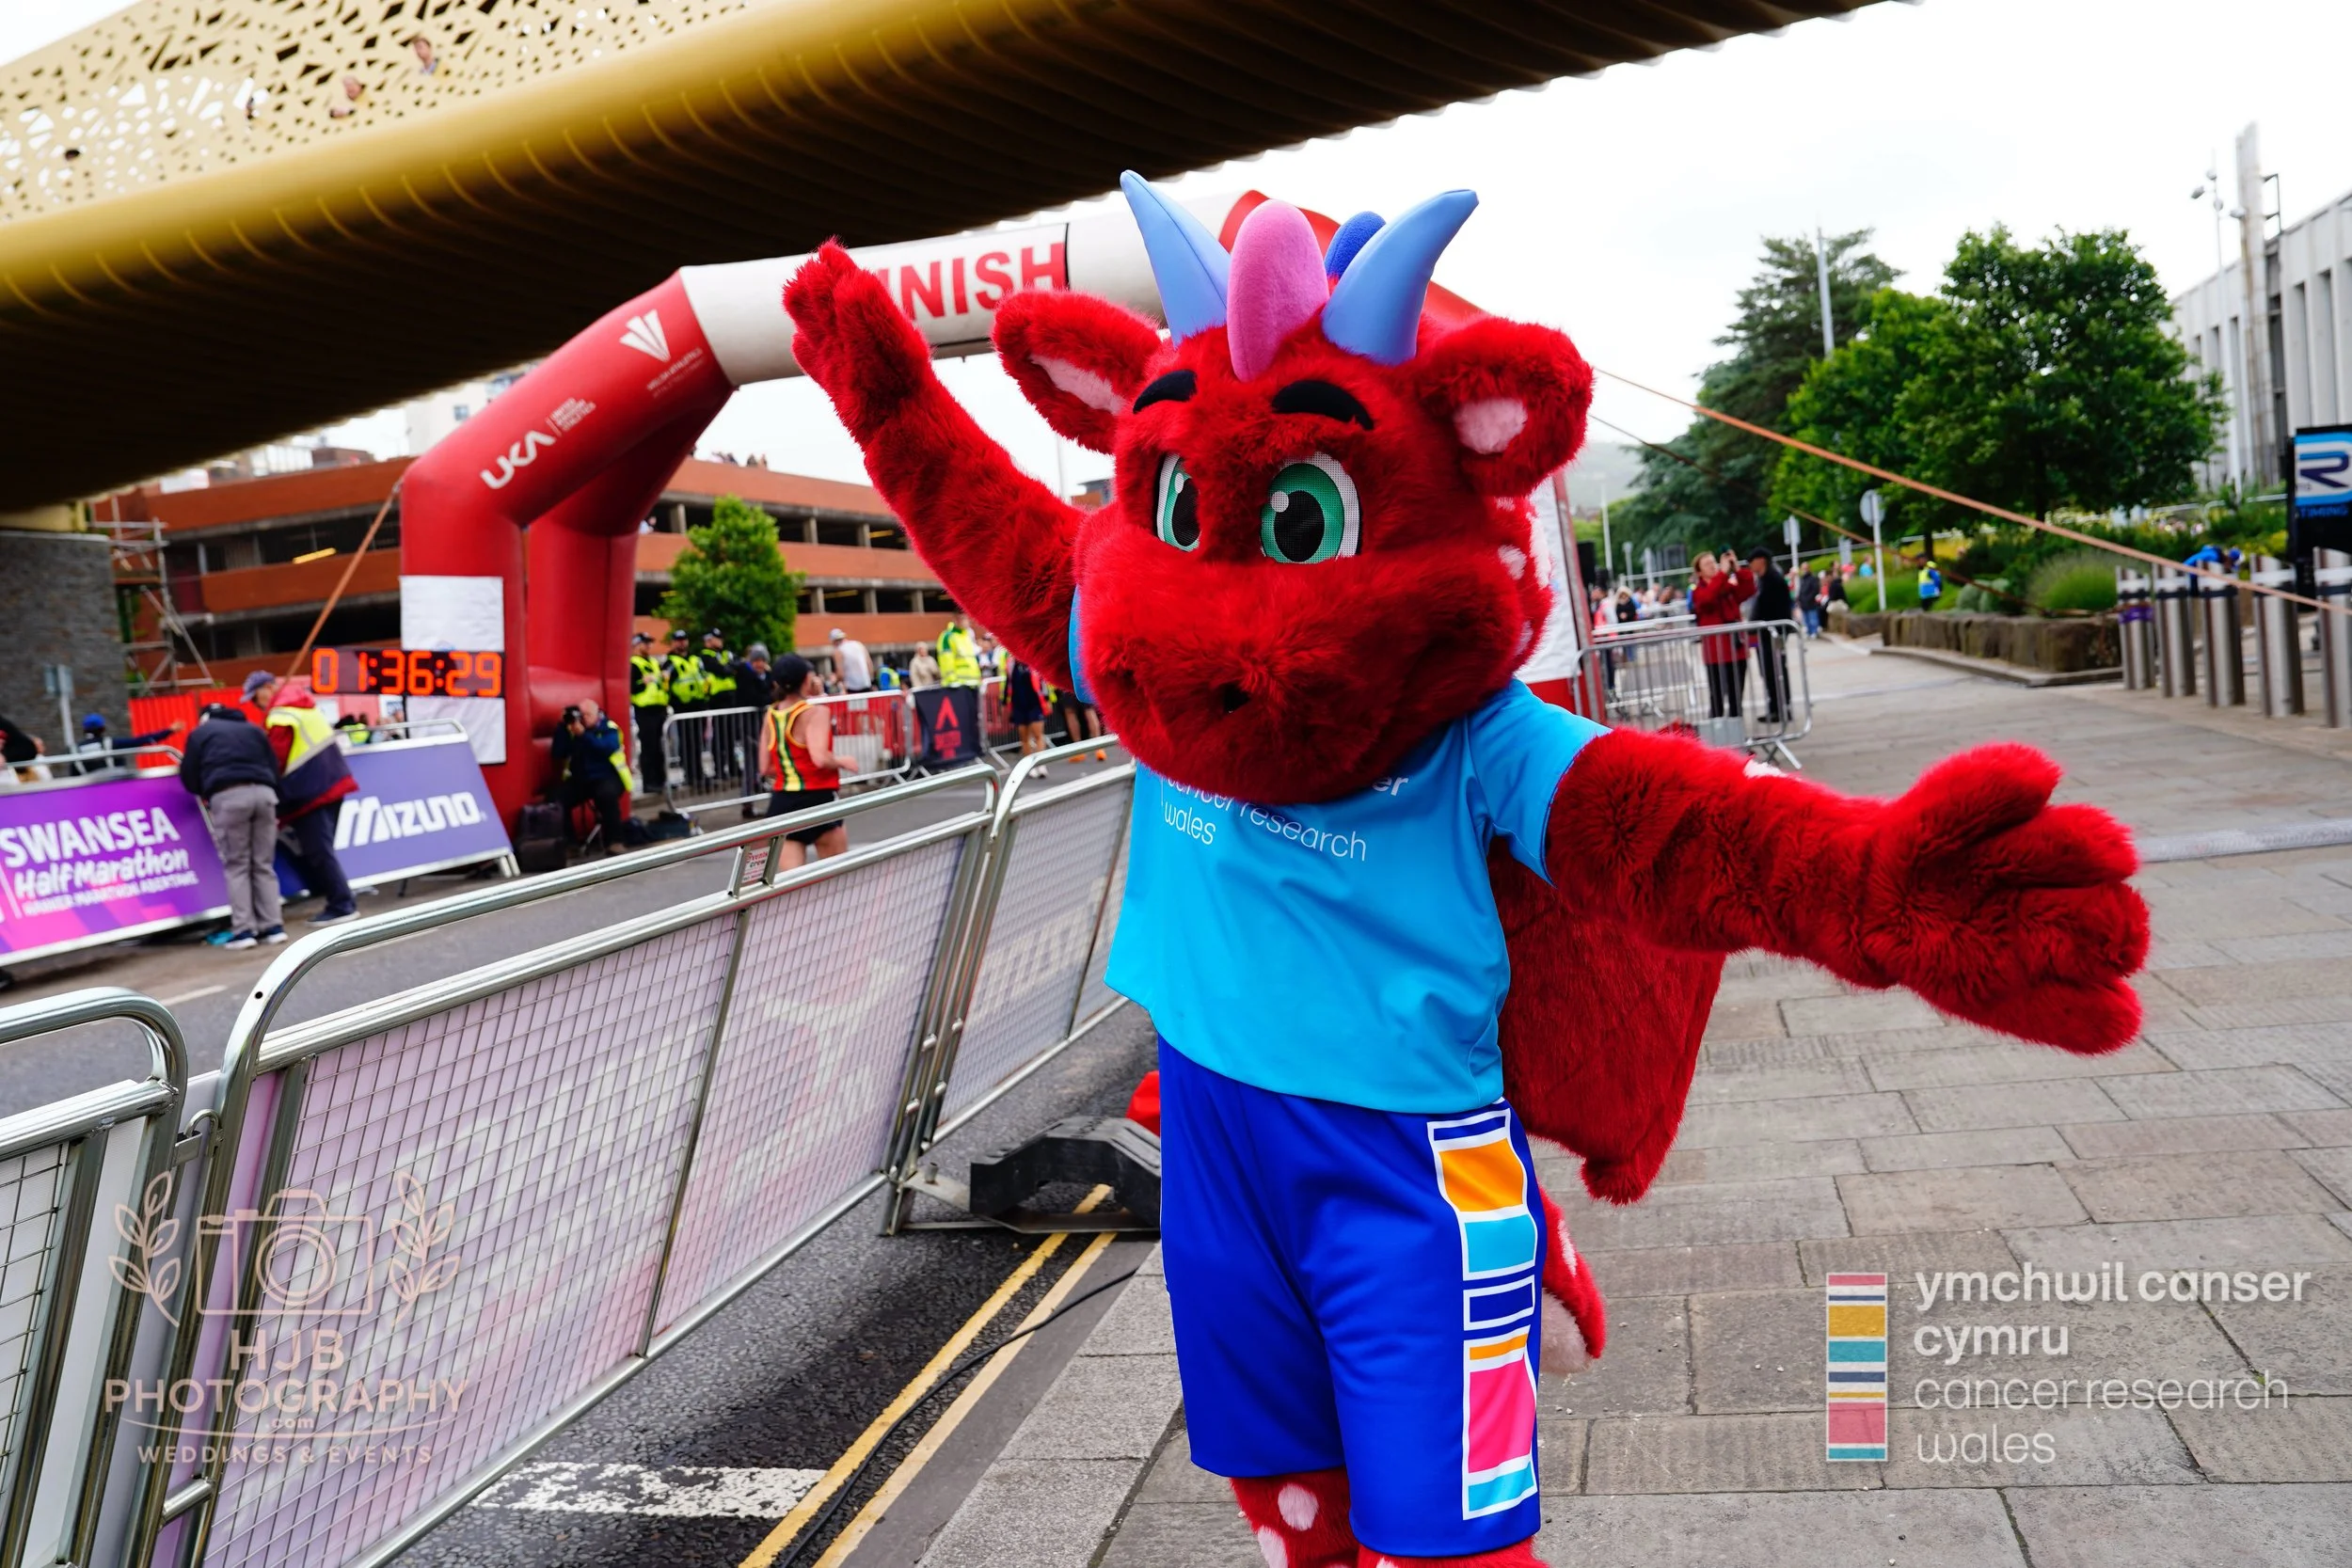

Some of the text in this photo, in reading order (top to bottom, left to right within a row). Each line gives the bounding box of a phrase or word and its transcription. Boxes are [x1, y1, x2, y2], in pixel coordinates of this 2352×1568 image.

[878, 242, 1067, 320] NISH
[311, 647, 502, 697] 01:36:29
[0, 806, 181, 868] SWANSEA
[1164, 801, 1216, 845] wales
[1240, 801, 1367, 861] research
[13, 847, 190, 900] Half Marathon
